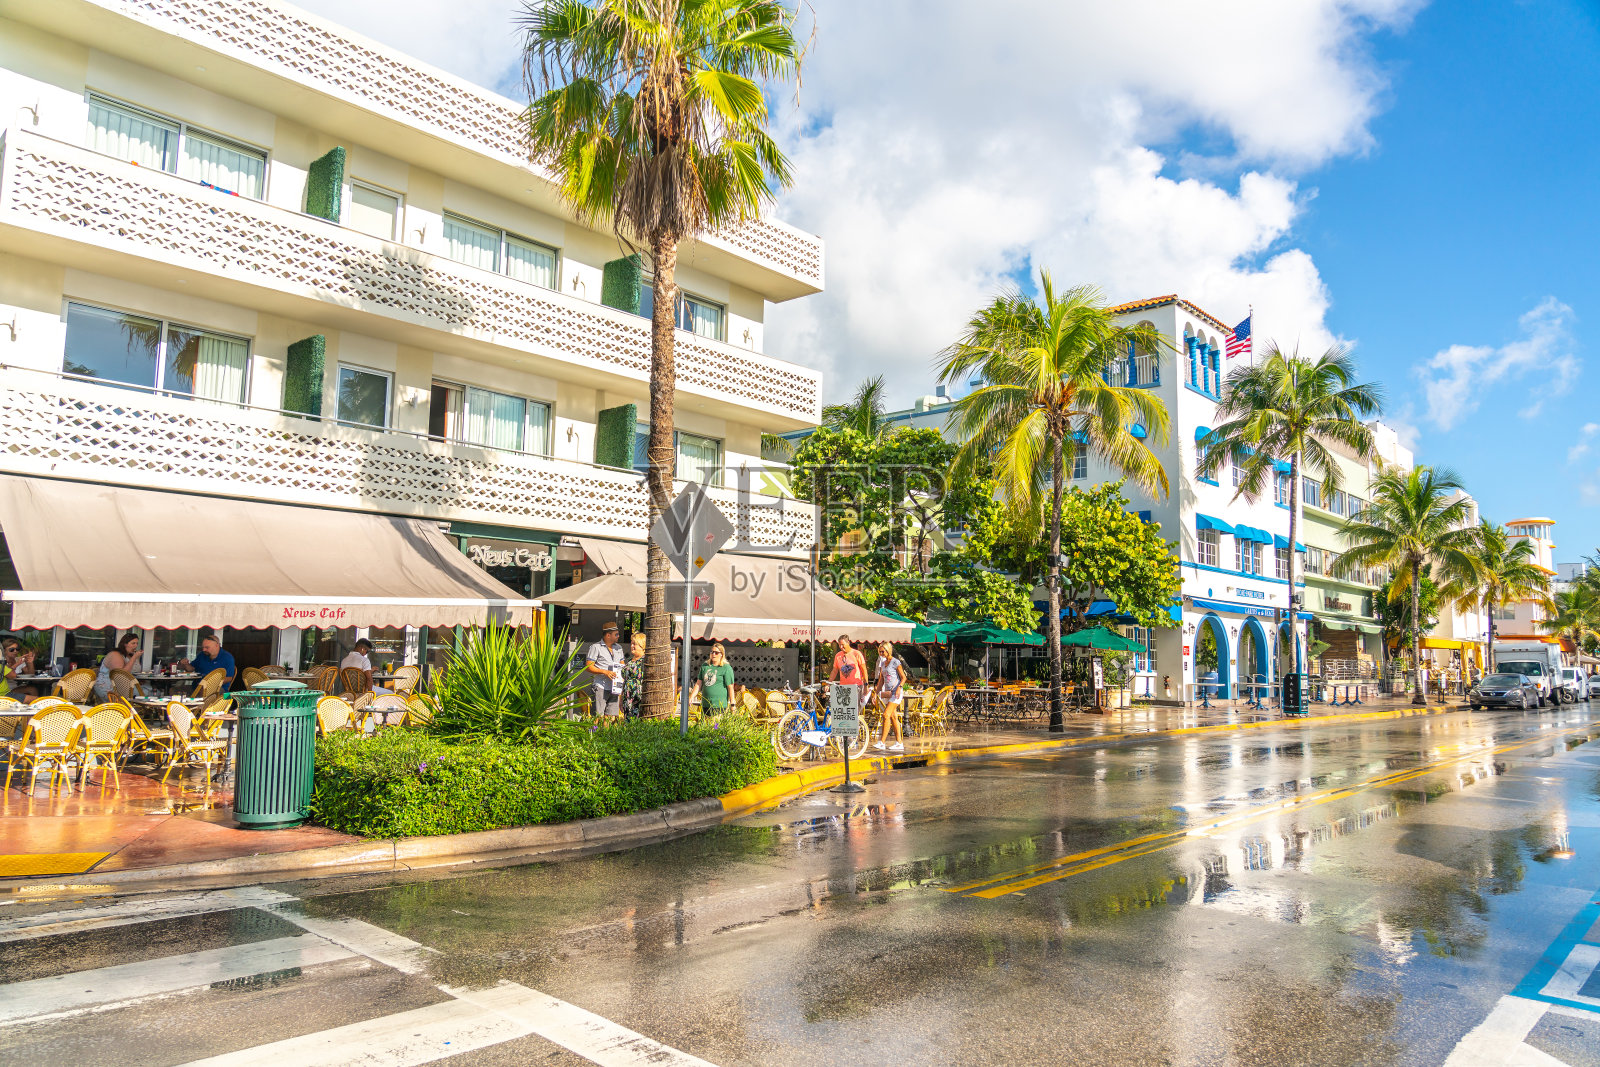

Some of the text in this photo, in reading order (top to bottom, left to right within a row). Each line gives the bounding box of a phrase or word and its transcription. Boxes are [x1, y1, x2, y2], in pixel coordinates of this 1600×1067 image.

[468, 544, 514, 567] News
[282, 607, 346, 621] News Cafe
[832, 707, 856, 715] VALET
